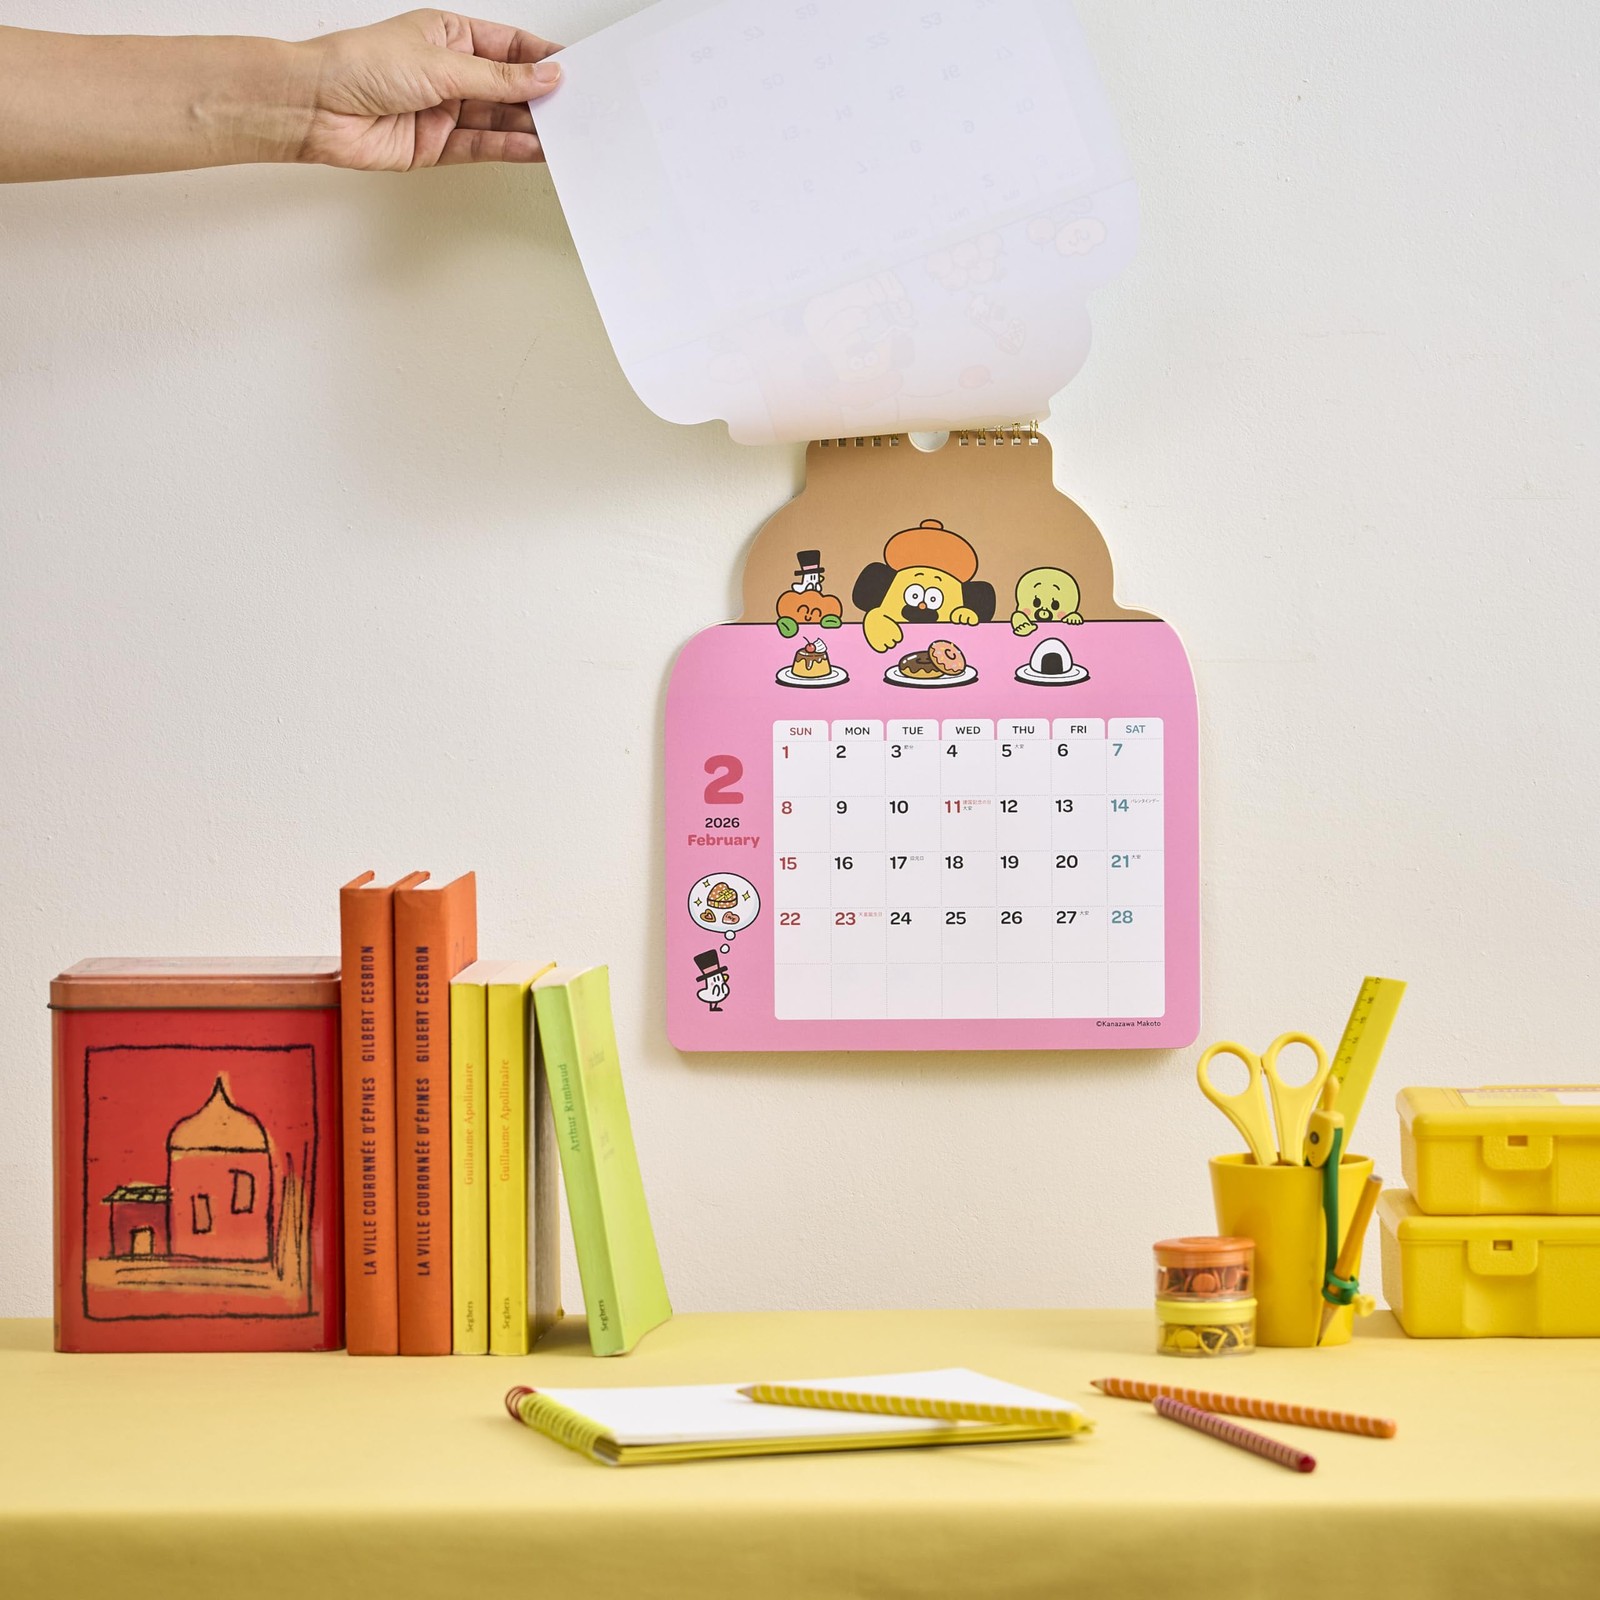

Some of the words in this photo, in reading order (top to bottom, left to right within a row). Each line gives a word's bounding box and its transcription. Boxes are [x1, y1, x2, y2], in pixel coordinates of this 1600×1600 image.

[845, 727, 869, 735] MON
[902, 727, 923, 735] TUE
[1013, 726, 1034, 734] THU
[1126, 725, 1145, 733] SAT
[782, 746, 788, 758] 1
[837, 745, 846, 758] 2
[892, 745, 901, 758] 3
[947, 745, 957, 757] 4
[1002, 744, 1011, 757] 5
[1058, 744, 1068, 756] 6
[1113, 744, 1122, 756] 7
[704, 754, 744, 804] 2
[706, 818, 739, 828] 2026
[782, 801, 792, 814] 8
[837, 801, 847, 814] 9
[890, 801, 908, 813] 10
[945, 800, 960, 813] 11
[1000, 800, 1017, 813] 12
[1056, 800, 1073, 812] 13
[1111, 799, 1129, 812] 14
[688, 834, 760, 848] February
[780, 857, 797, 870] 15
[835, 857, 853, 869] 16
[890, 856, 907, 869] 17
[945, 856, 963, 869] 18
[1001, 856, 1018, 868] 19
[1056, 855, 1078, 868] 20
[1112, 855, 1128, 868] 21
[780, 913, 800, 925] 22
[836, 912, 855, 925] 23
[891, 912, 912, 925] 24
[946, 912, 966, 924] 25
[1001, 911, 1022, 924] 26
[1057, 911, 1076, 923] 27
[1112, 910, 1133, 923] 28
[360, 945, 374, 1004] CESBRON
[416, 946, 428, 1005] CESBRON
[362, 1011, 375, 1062] GILBERT
[417, 1011, 429, 1062] GILBERT
[360, 1077, 376, 1135] D'ÉPINES
[415, 1078, 429, 1136] D'ÉPINES
[464, 1063, 476, 1124] Apollinaire
[501, 1059, 512, 1120] Apollinaire
[557, 1063, 574, 1113] Rimbaud
[568, 1116, 580, 1152] Arthur
[464, 1128, 474, 1185] Guillaume
[500, 1124, 510, 1183] Guillaume
[360, 1140, 376, 1214] COURONNÉE
[415, 1140, 430, 1215] COURONNÉE
[364, 1217, 376, 1255] VILLE
[417, 1218, 430, 1256] VILLE
[365, 1258, 376, 1275] LA
[418, 1260, 430, 1276] LA
[466, 1301, 474, 1332] Seghers
[503, 1297, 511, 1329] Seghers
[598, 1299, 608, 1331] Seghers
